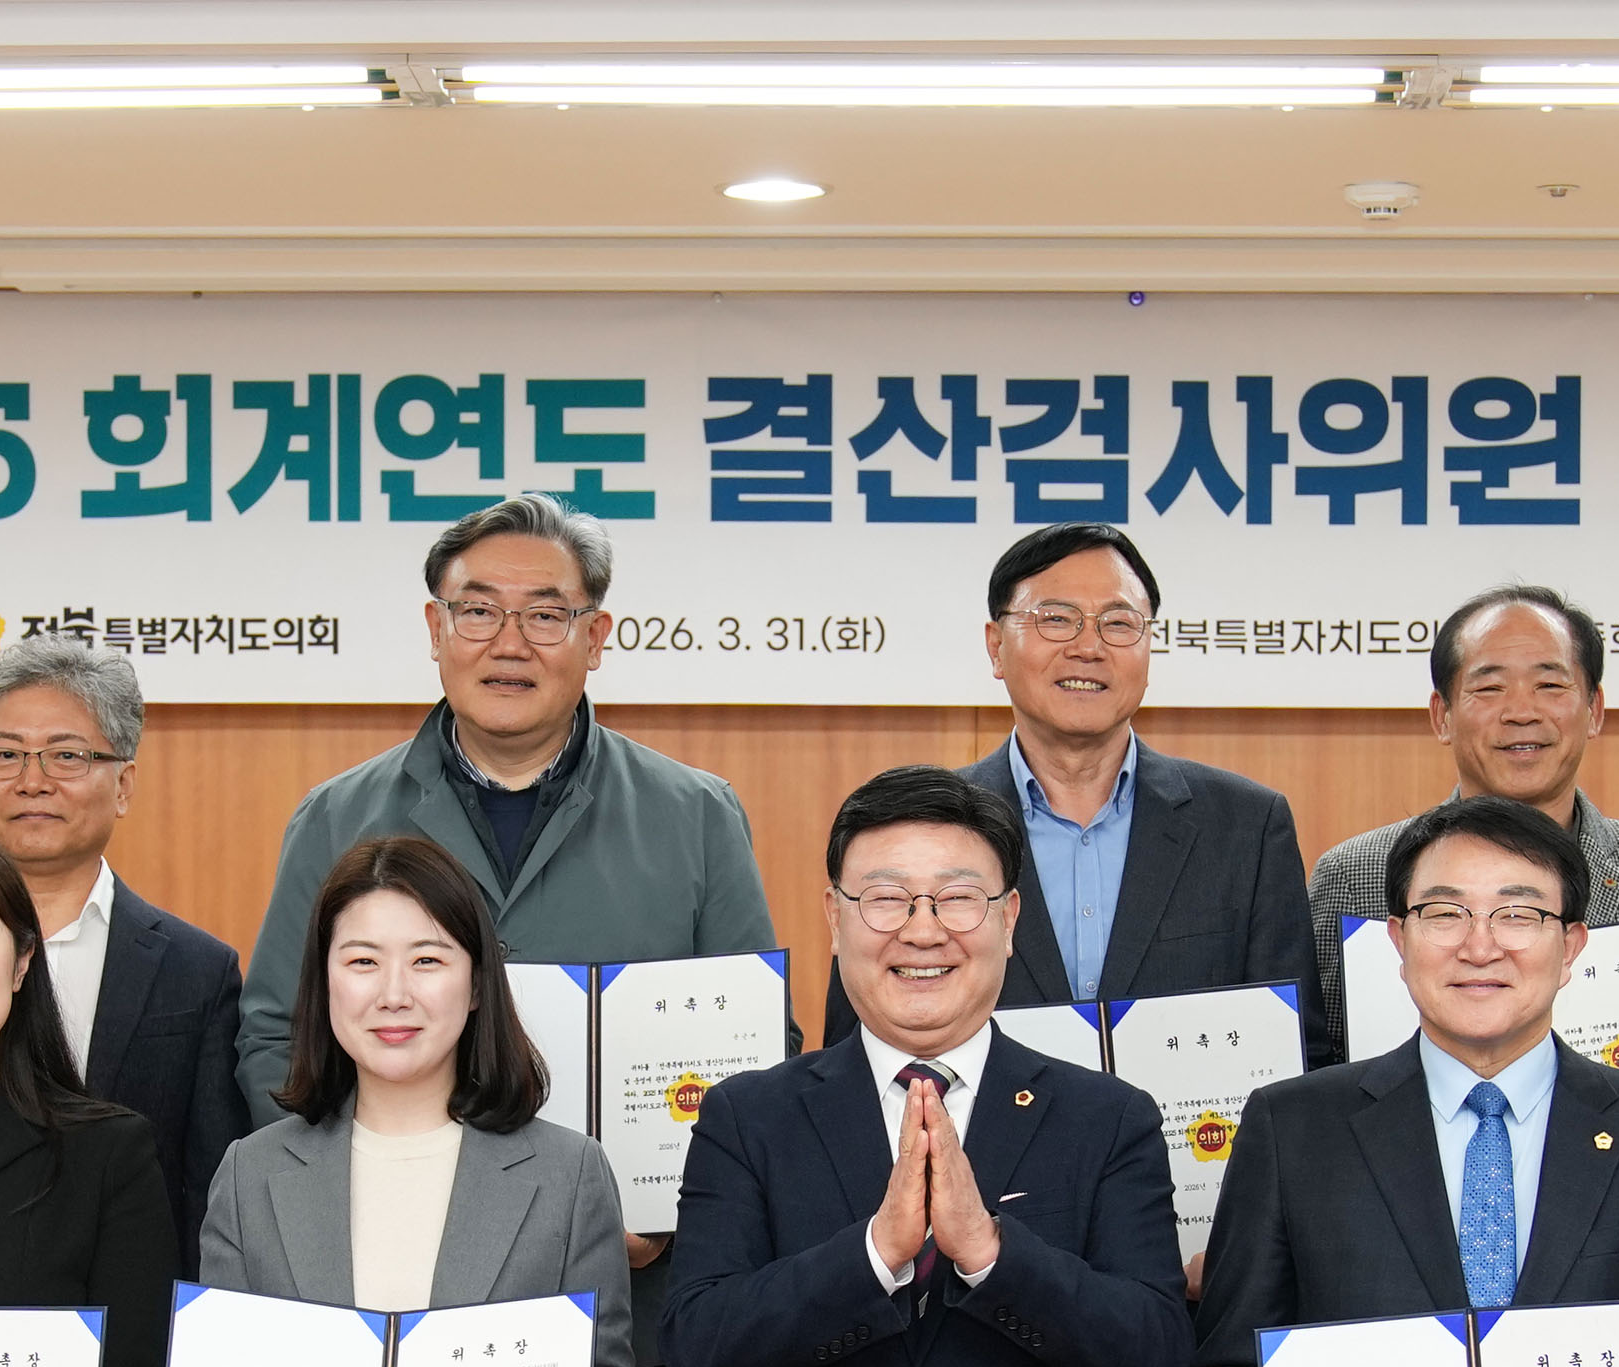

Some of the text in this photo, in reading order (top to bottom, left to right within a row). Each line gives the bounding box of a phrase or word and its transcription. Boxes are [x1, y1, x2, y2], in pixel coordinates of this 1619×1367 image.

[80, 373, 657, 523] 회계연도
[703, 373, 1583, 528] 결산검사위원
[603, 616, 703, 651] 026.
[1199, 1130, 1223, 1144] 의회
